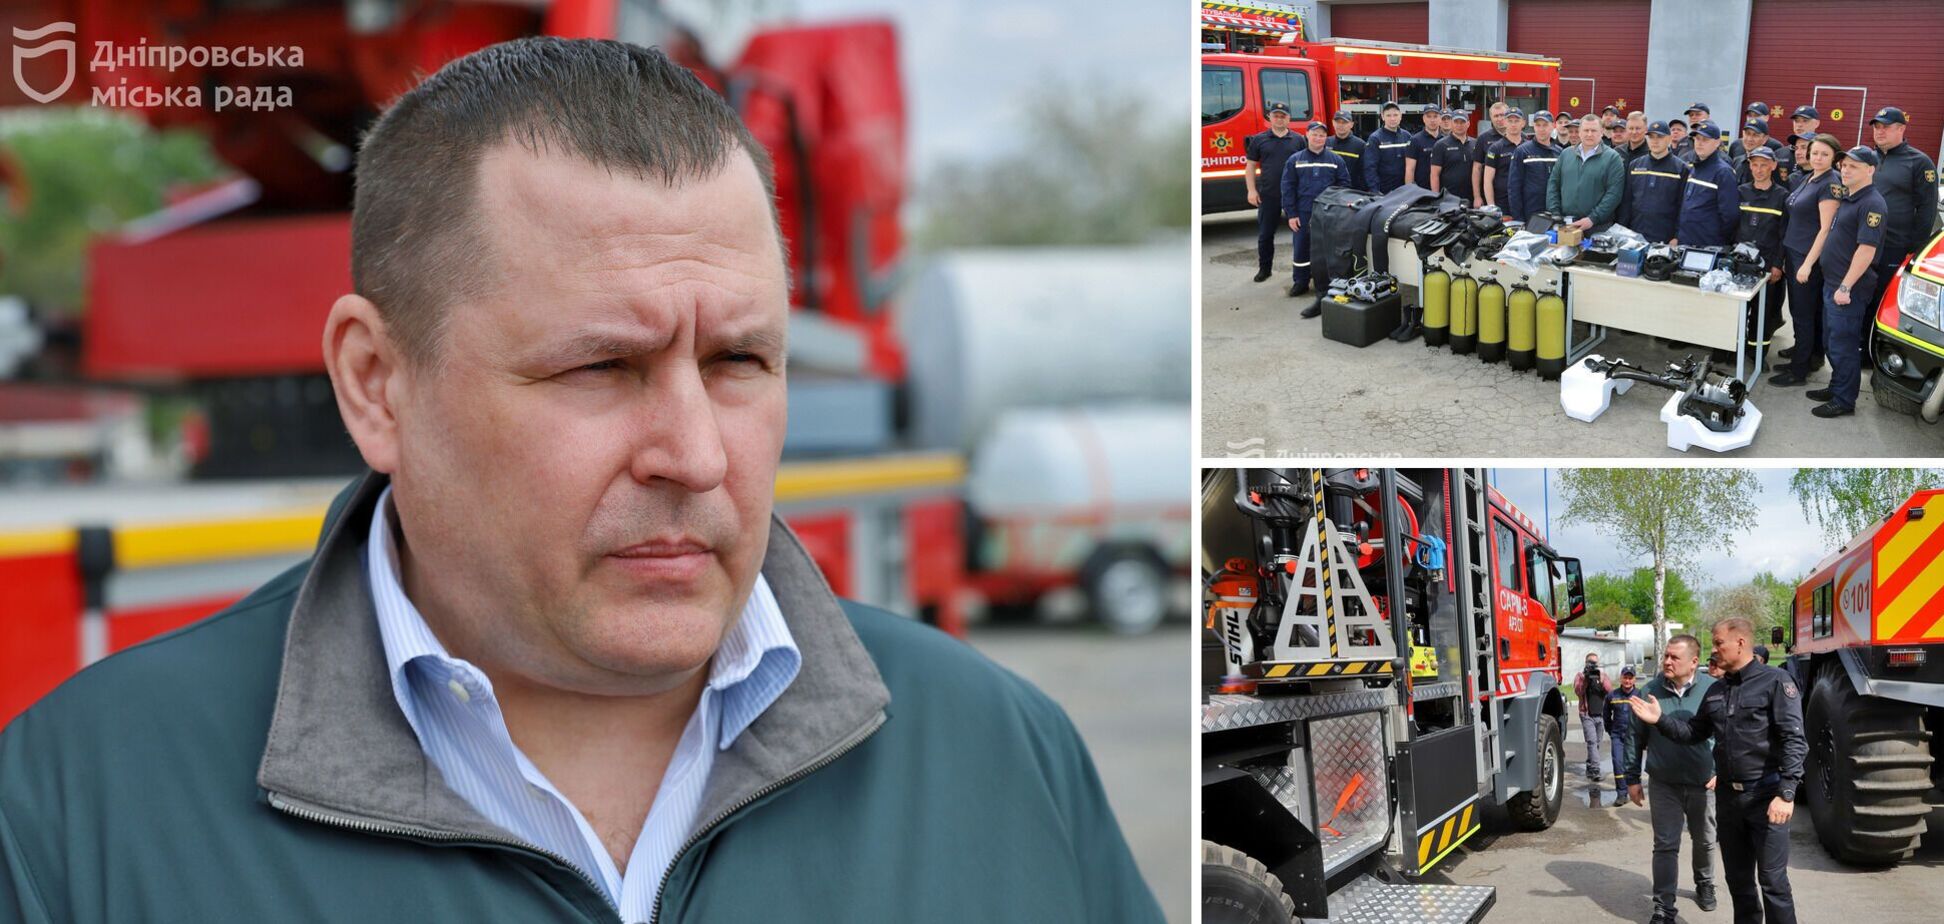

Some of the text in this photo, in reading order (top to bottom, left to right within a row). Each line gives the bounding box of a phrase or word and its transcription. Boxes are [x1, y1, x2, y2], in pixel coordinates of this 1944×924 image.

[1201, 155, 1247, 167] ДНІПРО
[1851, 579, 1870, 615] 101
[1226, 611, 1243, 666] STIHL
